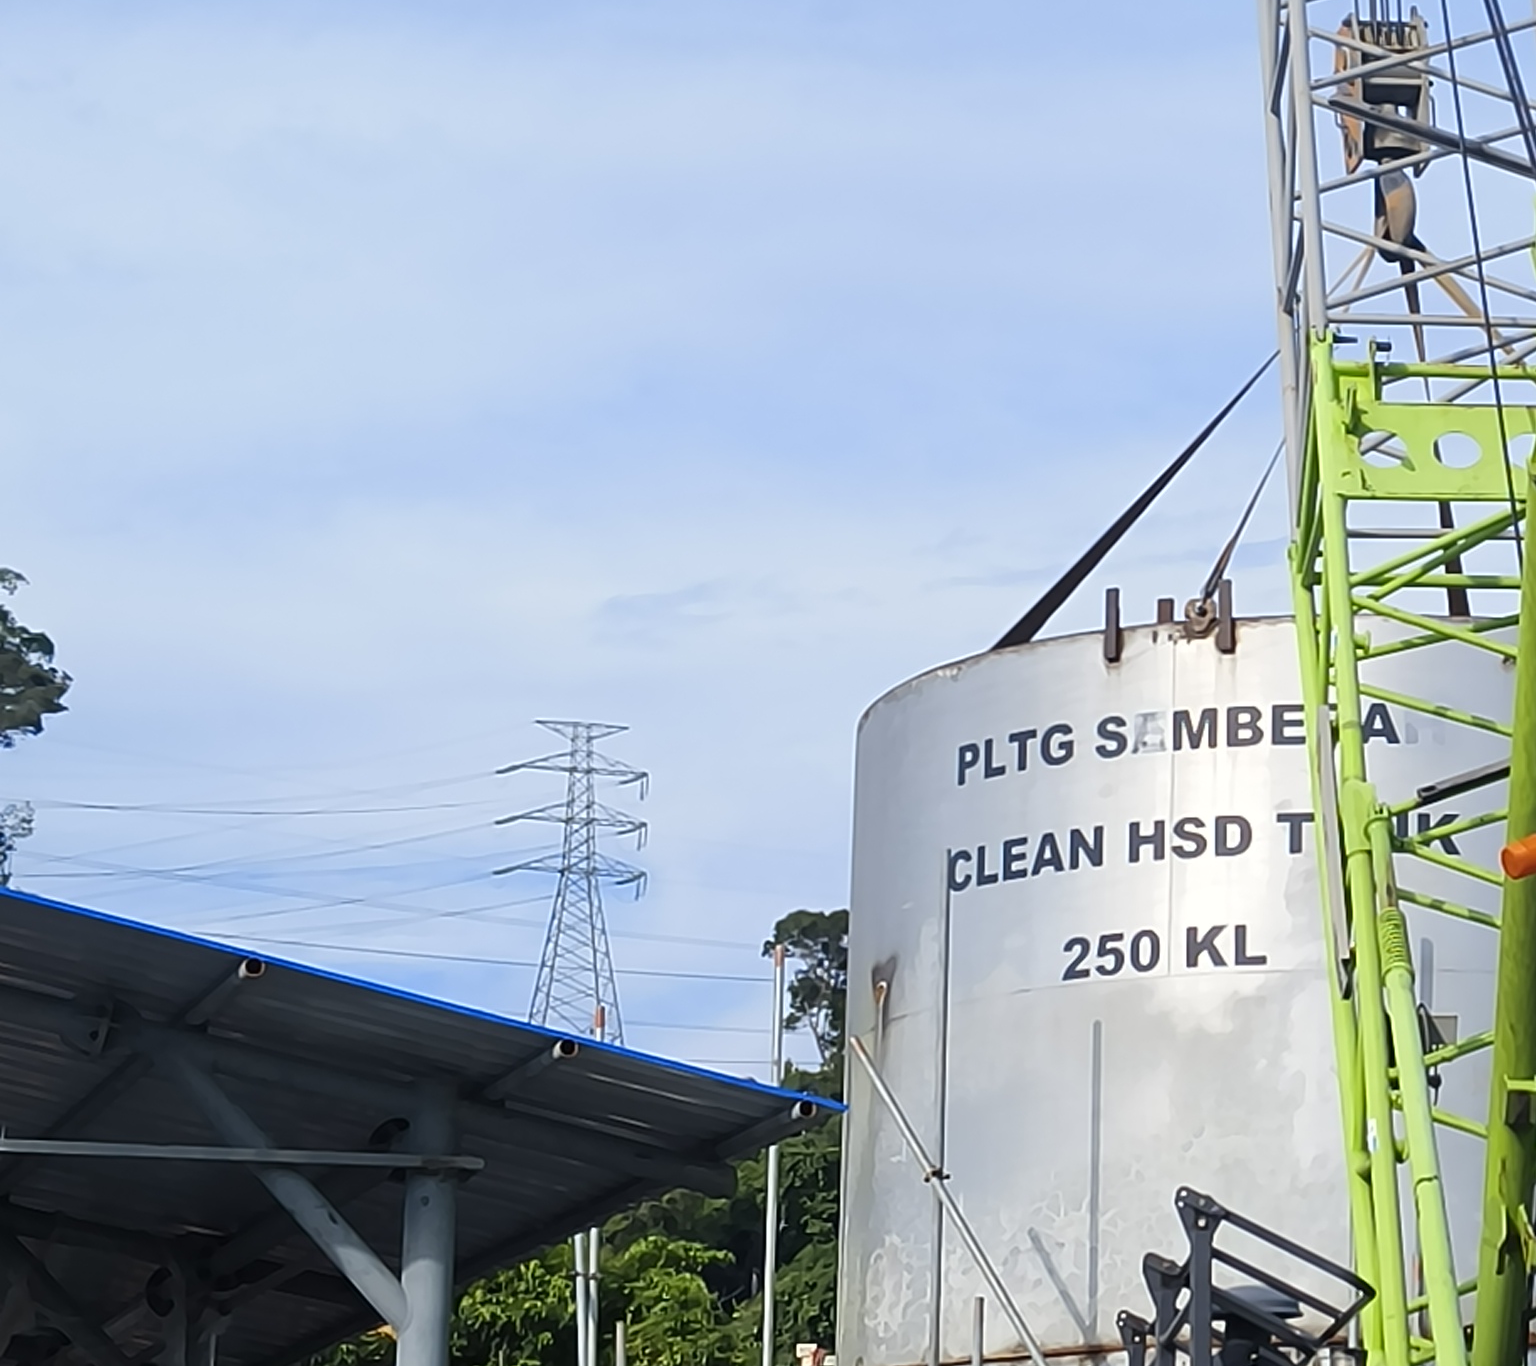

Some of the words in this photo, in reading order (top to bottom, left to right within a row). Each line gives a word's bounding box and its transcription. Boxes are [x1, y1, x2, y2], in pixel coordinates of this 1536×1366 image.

[957, 723, 1075, 786] PLTG
[1095, 703, 1401, 759] SMBEA
[949, 825, 1104, 892] CLEAN
[1128, 815, 1253, 864] HSD
[1276, 812, 1461, 856] TK
[1061, 929, 1160, 982] 250
[1186, 924, 1268, 968] KL
